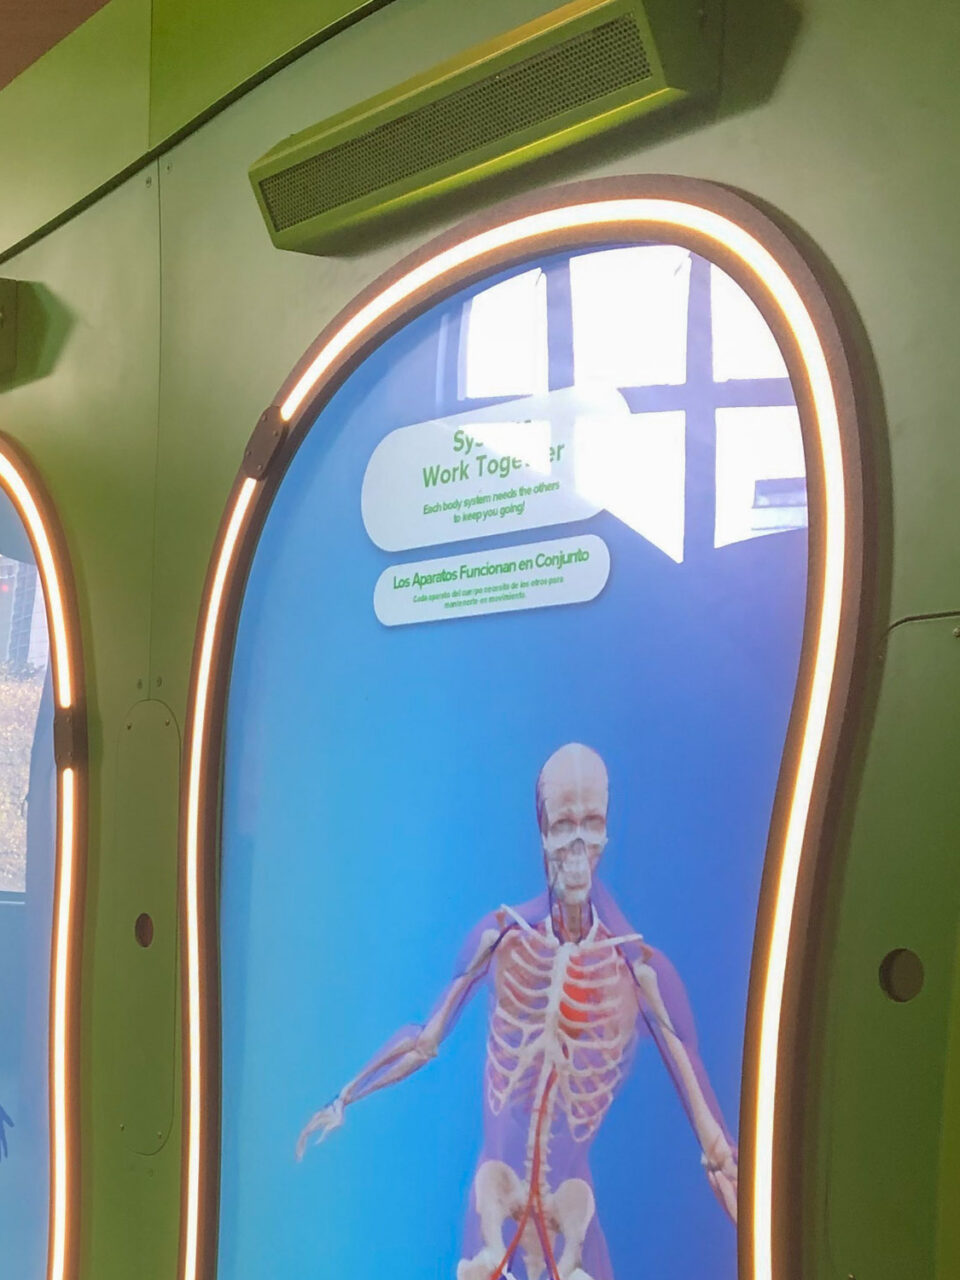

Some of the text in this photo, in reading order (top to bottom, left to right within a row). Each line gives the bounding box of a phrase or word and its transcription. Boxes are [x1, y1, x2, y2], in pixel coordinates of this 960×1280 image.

[422, 444, 565, 488] Work Toger
[423, 480, 560, 515] Each body system needs the others
[453, 501, 526, 524] to keep you going!
[393, 548, 589, 590] Los Aparatos Funcionan en Conjunto
